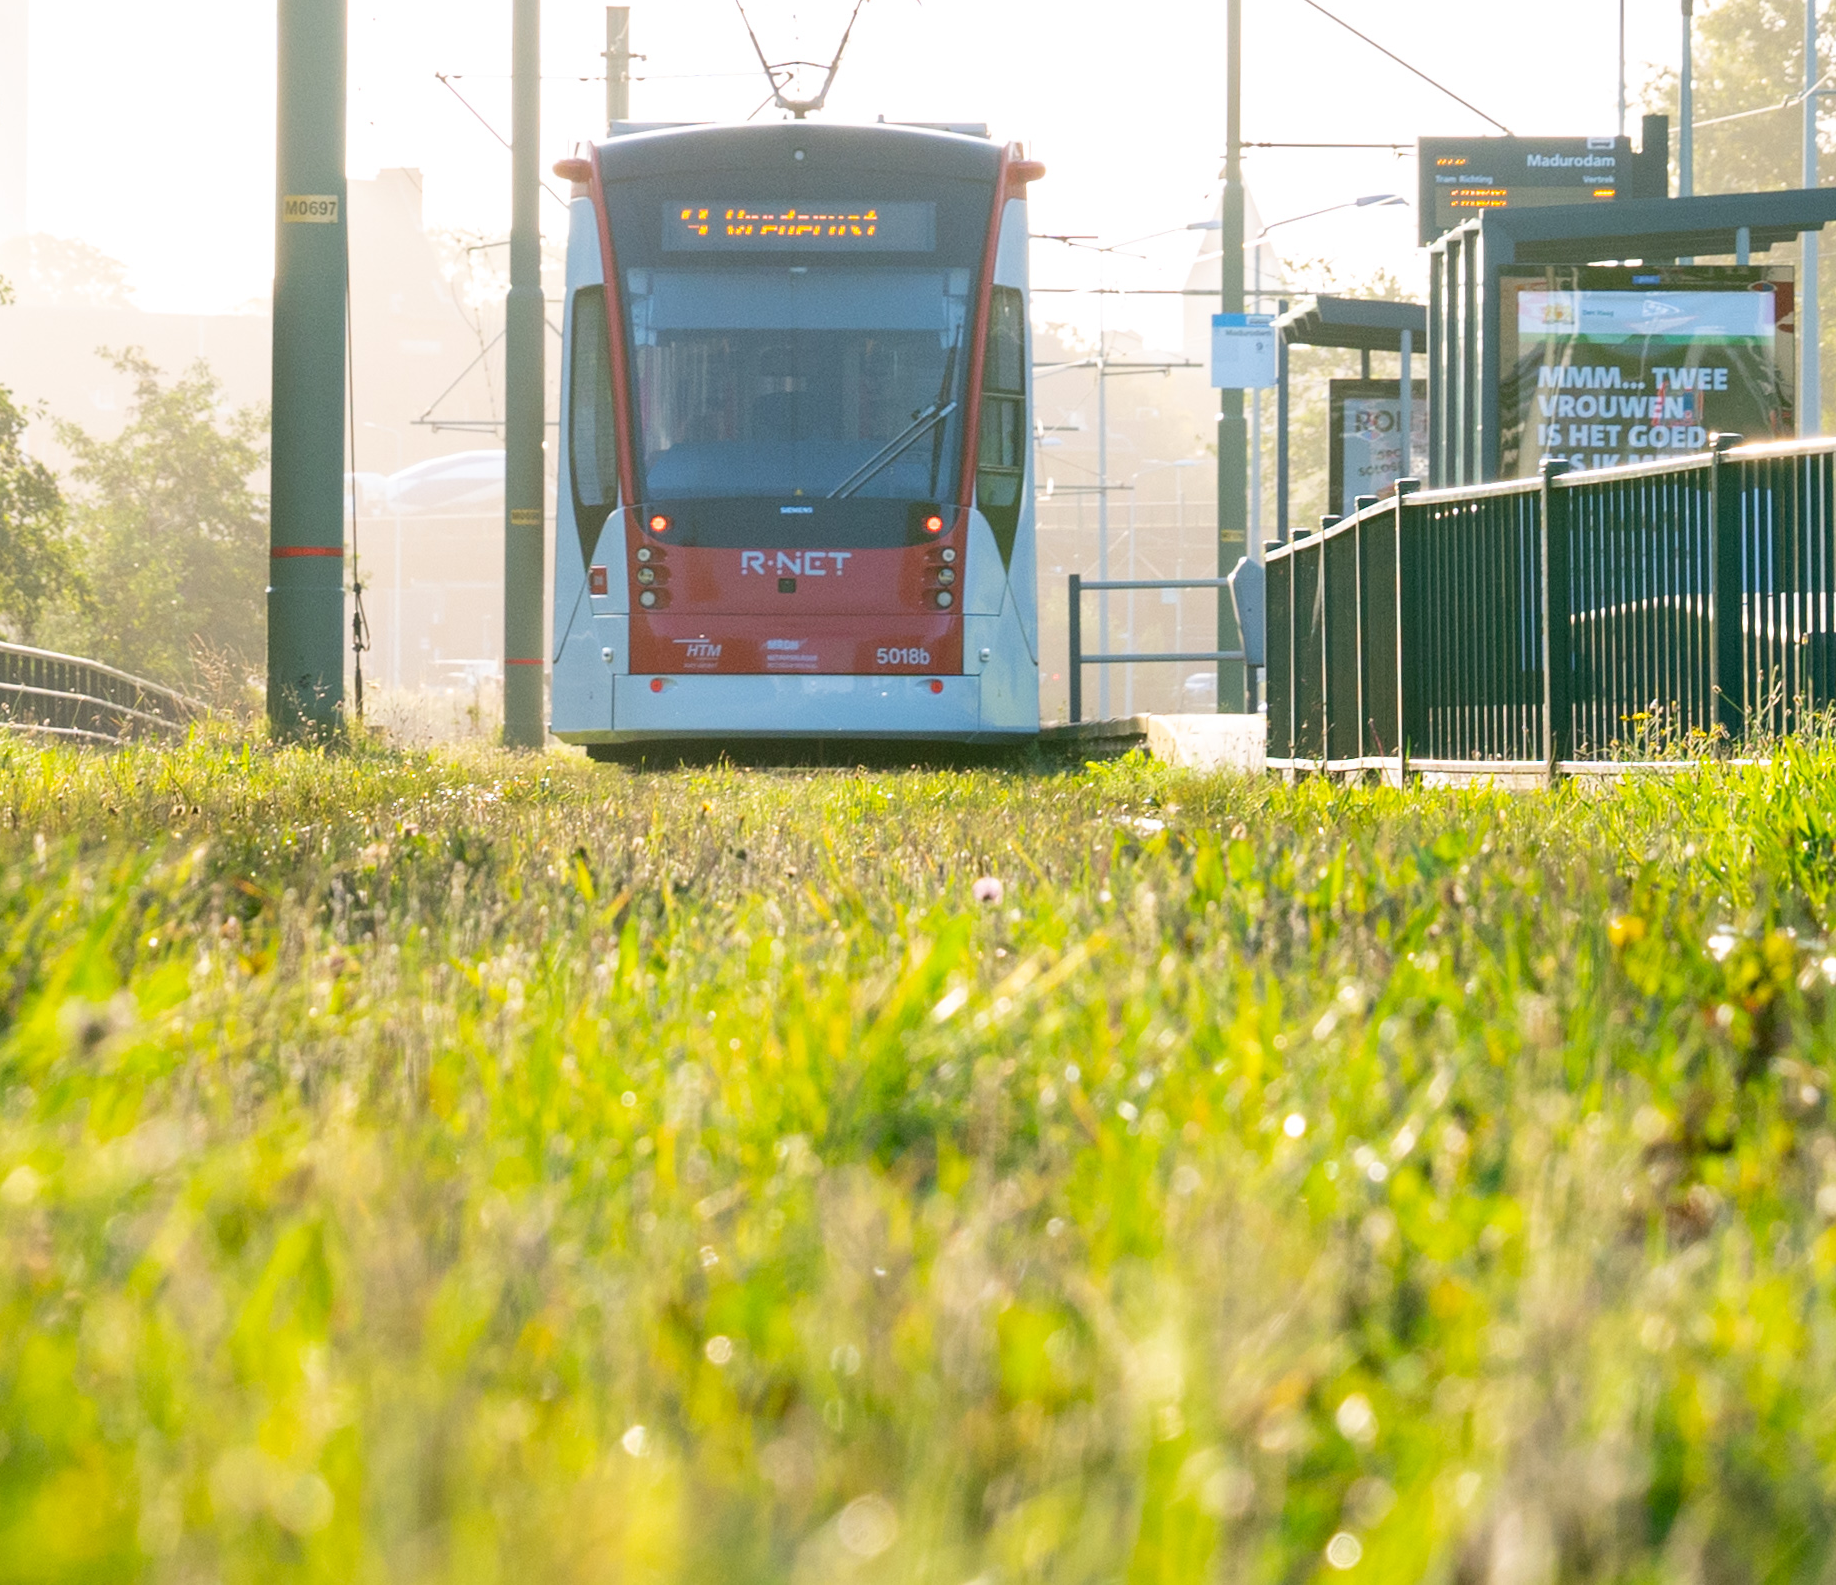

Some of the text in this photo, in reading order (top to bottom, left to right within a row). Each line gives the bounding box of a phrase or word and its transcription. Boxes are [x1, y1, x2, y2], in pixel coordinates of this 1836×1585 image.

[1526, 152, 1615, 168] Madurodam
[284, 200, 337, 216] M0697
[1537, 367, 1729, 391] MMM... TWEE
[1537, 424, 1707, 449] IS HET GOED
[686, 644, 722, 657] HTM
